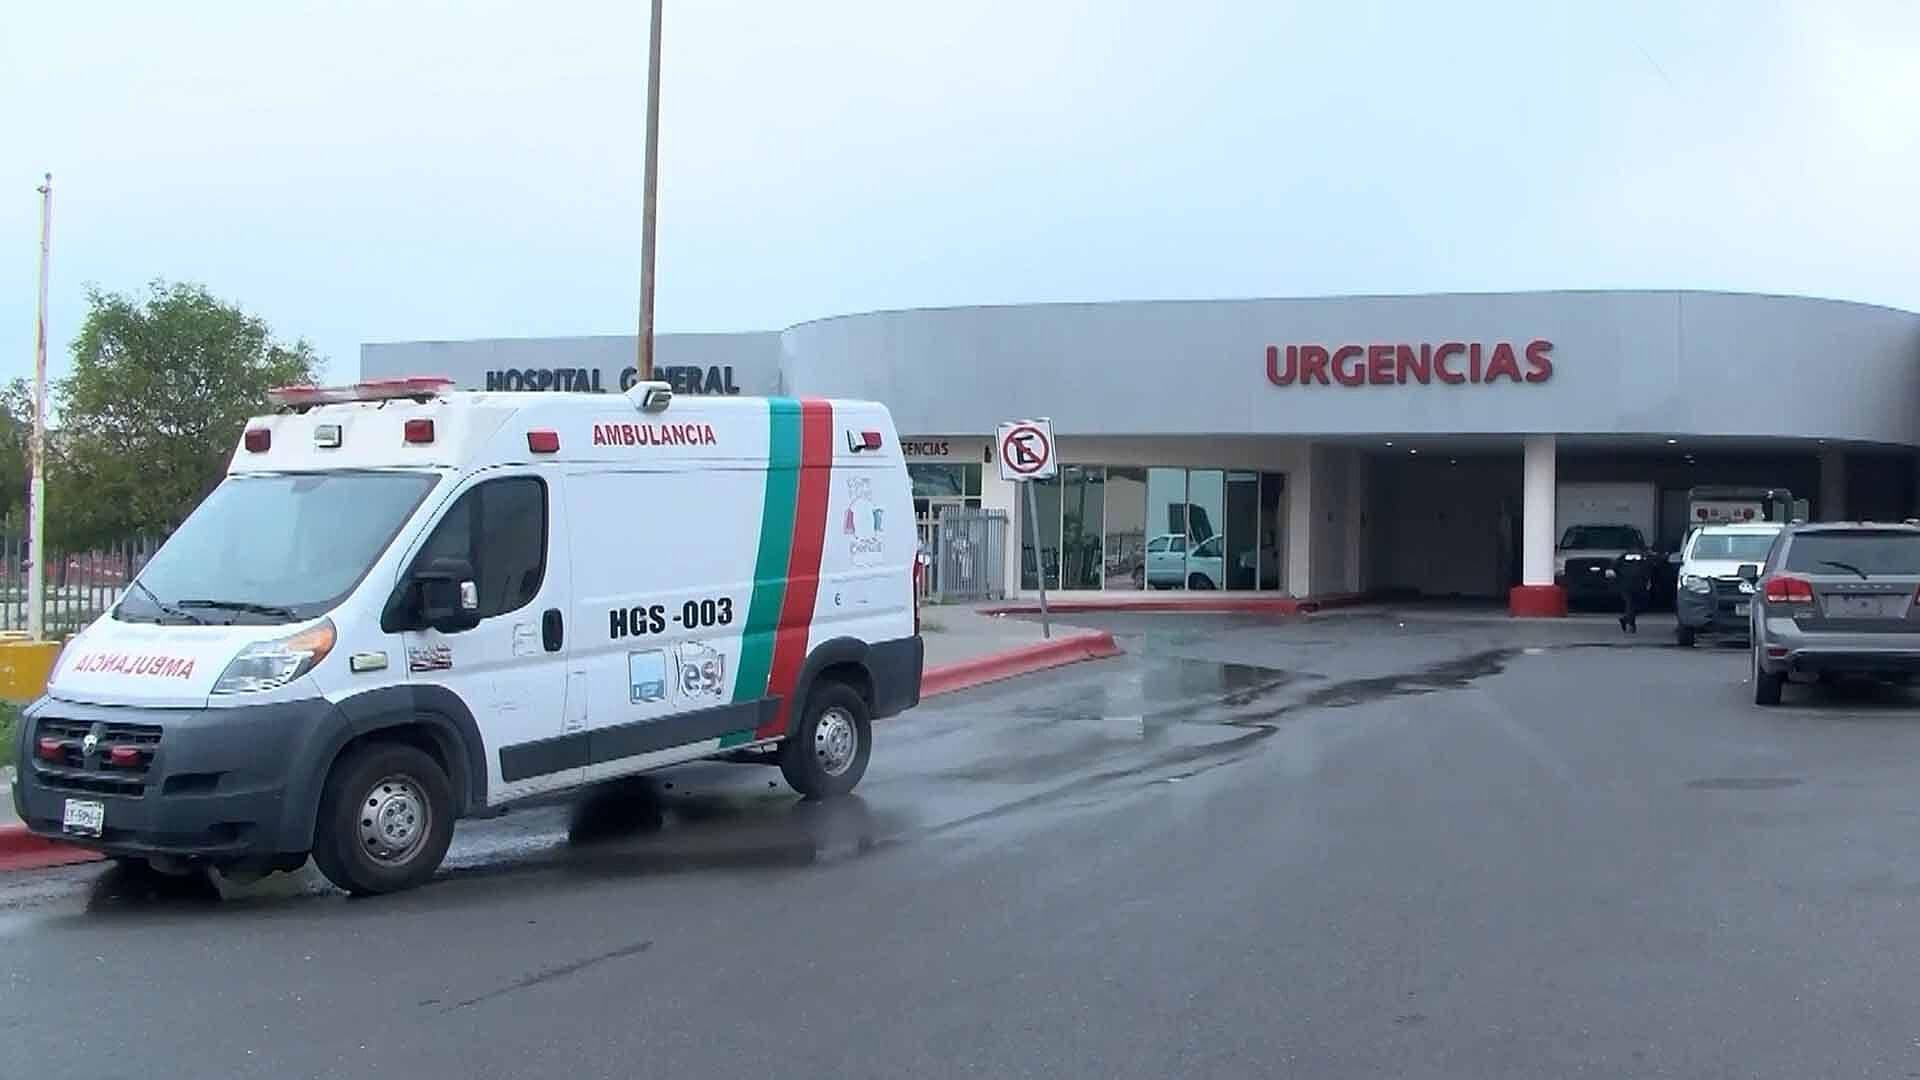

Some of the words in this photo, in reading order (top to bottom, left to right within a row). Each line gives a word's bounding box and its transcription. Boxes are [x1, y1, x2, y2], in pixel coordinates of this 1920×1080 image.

[486, 369, 607, 393] HOSPITAL
[619, 366, 741, 395] GNERAL
[1265, 340, 1555, 386] URGENCIAS
[593, 424, 717, 446] AMBULANCIA
[609, 604, 666, 639] HGS
[672, 597, 733, 629] -003
